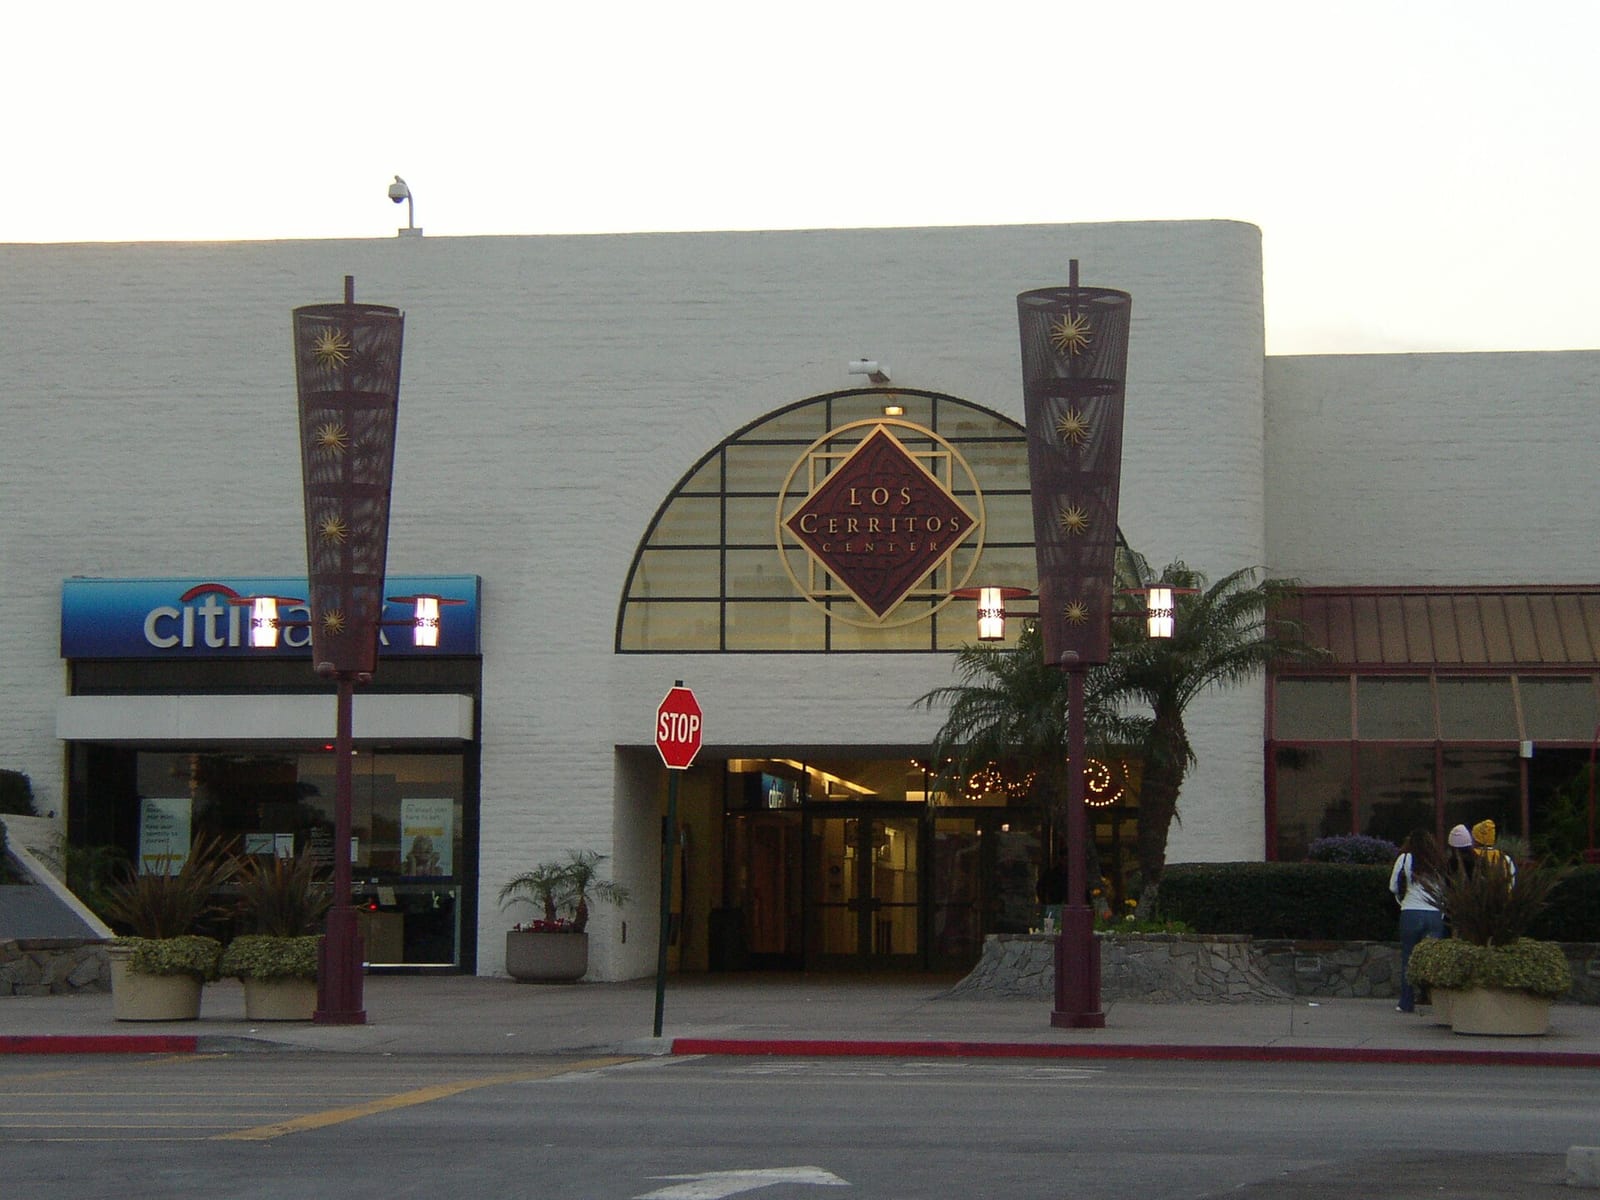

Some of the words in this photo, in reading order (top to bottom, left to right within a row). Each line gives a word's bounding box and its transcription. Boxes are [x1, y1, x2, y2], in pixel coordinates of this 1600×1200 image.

[850, 487, 911, 506] LOS
[800, 513, 960, 534] CERRITOS
[822, 542, 938, 552] CENTER
[144, 594, 390, 648] citia
[659, 711, 700, 744] STOP
